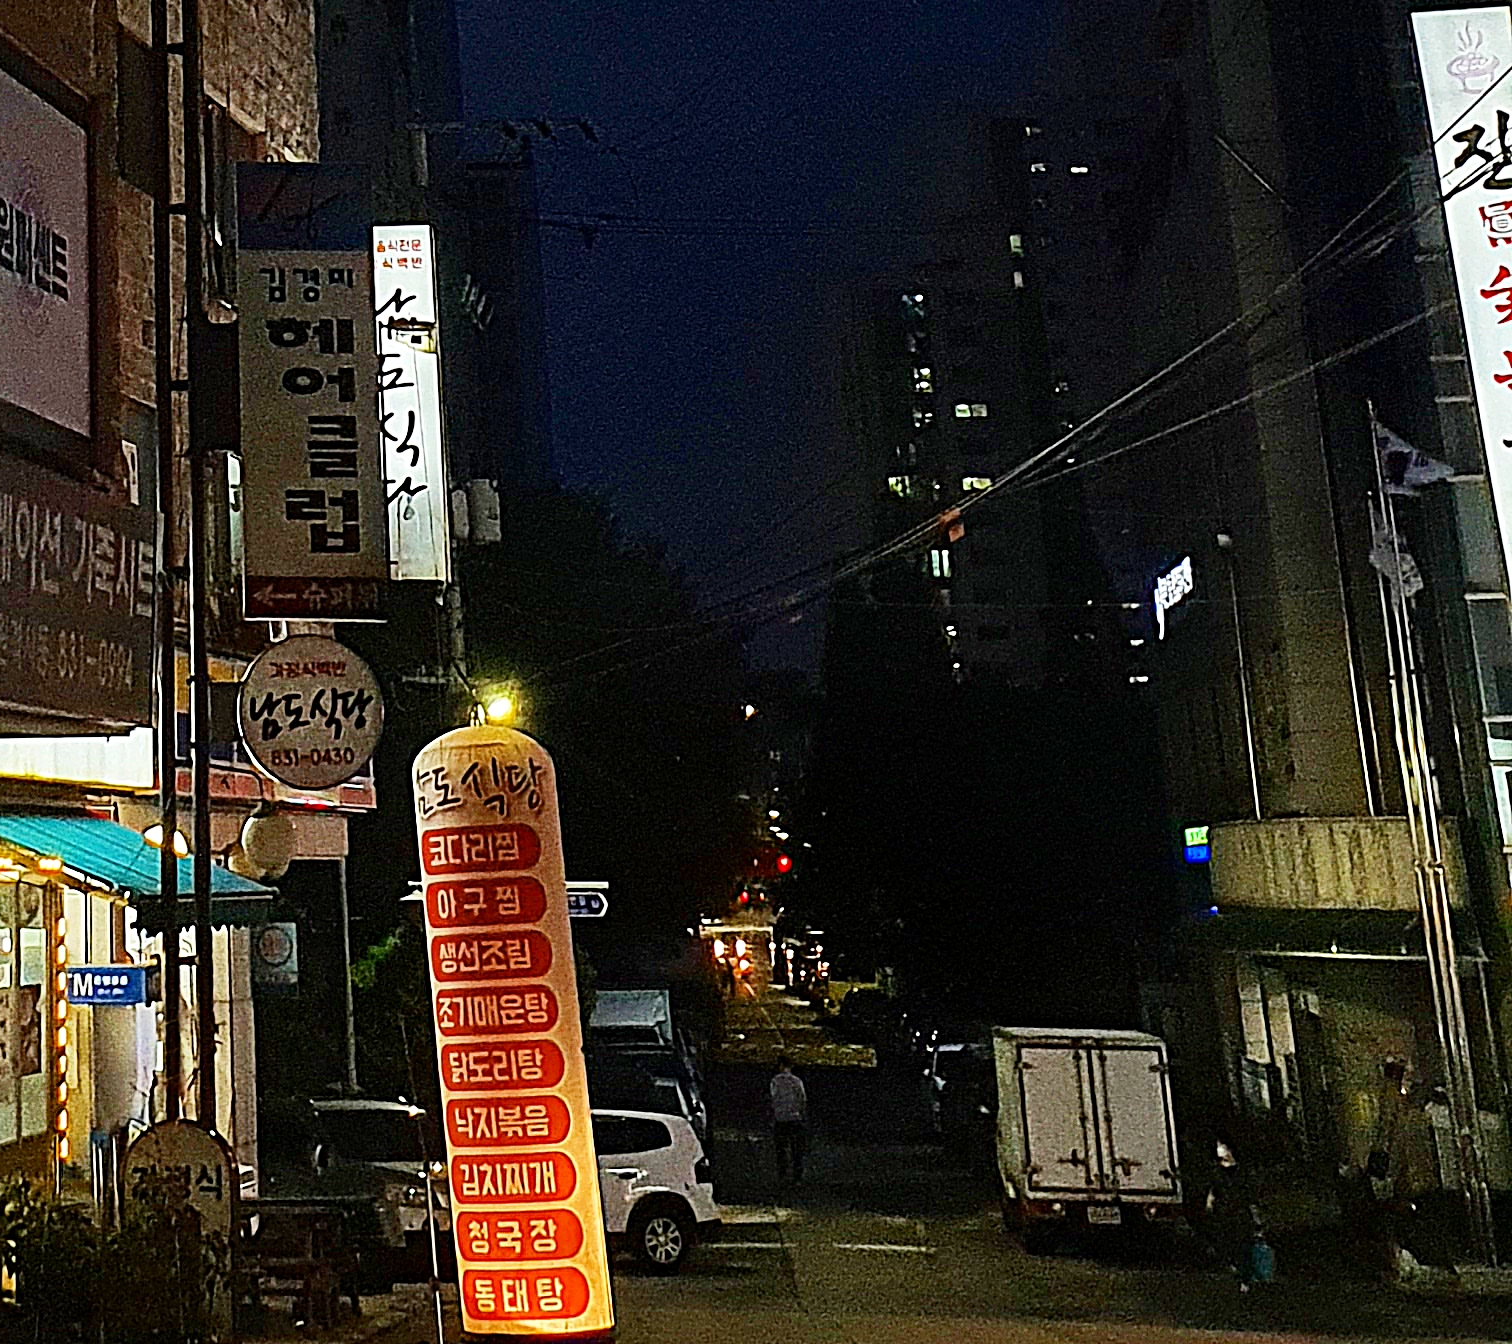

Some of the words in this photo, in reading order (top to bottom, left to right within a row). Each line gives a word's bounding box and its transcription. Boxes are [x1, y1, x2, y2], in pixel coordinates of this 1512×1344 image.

[266, 316, 361, 554] 헤어클럽
[249, 686, 374, 741] 남도식당
[428, 830, 520, 867] 코다리찜
[437, 884, 521, 921] 아구찜
[439, 938, 531, 975] 생선조림
[439, 992, 550, 1028] 조기매운탕
[449, 1047, 545, 1085] 닭도리탕
[454, 1103, 550, 1140] 낙지볶음
[460, 1159, 557, 1198] 김치찌개
[468, 1217, 559, 1255] 청국장
[474, 1275, 565, 1314] 동태탕
